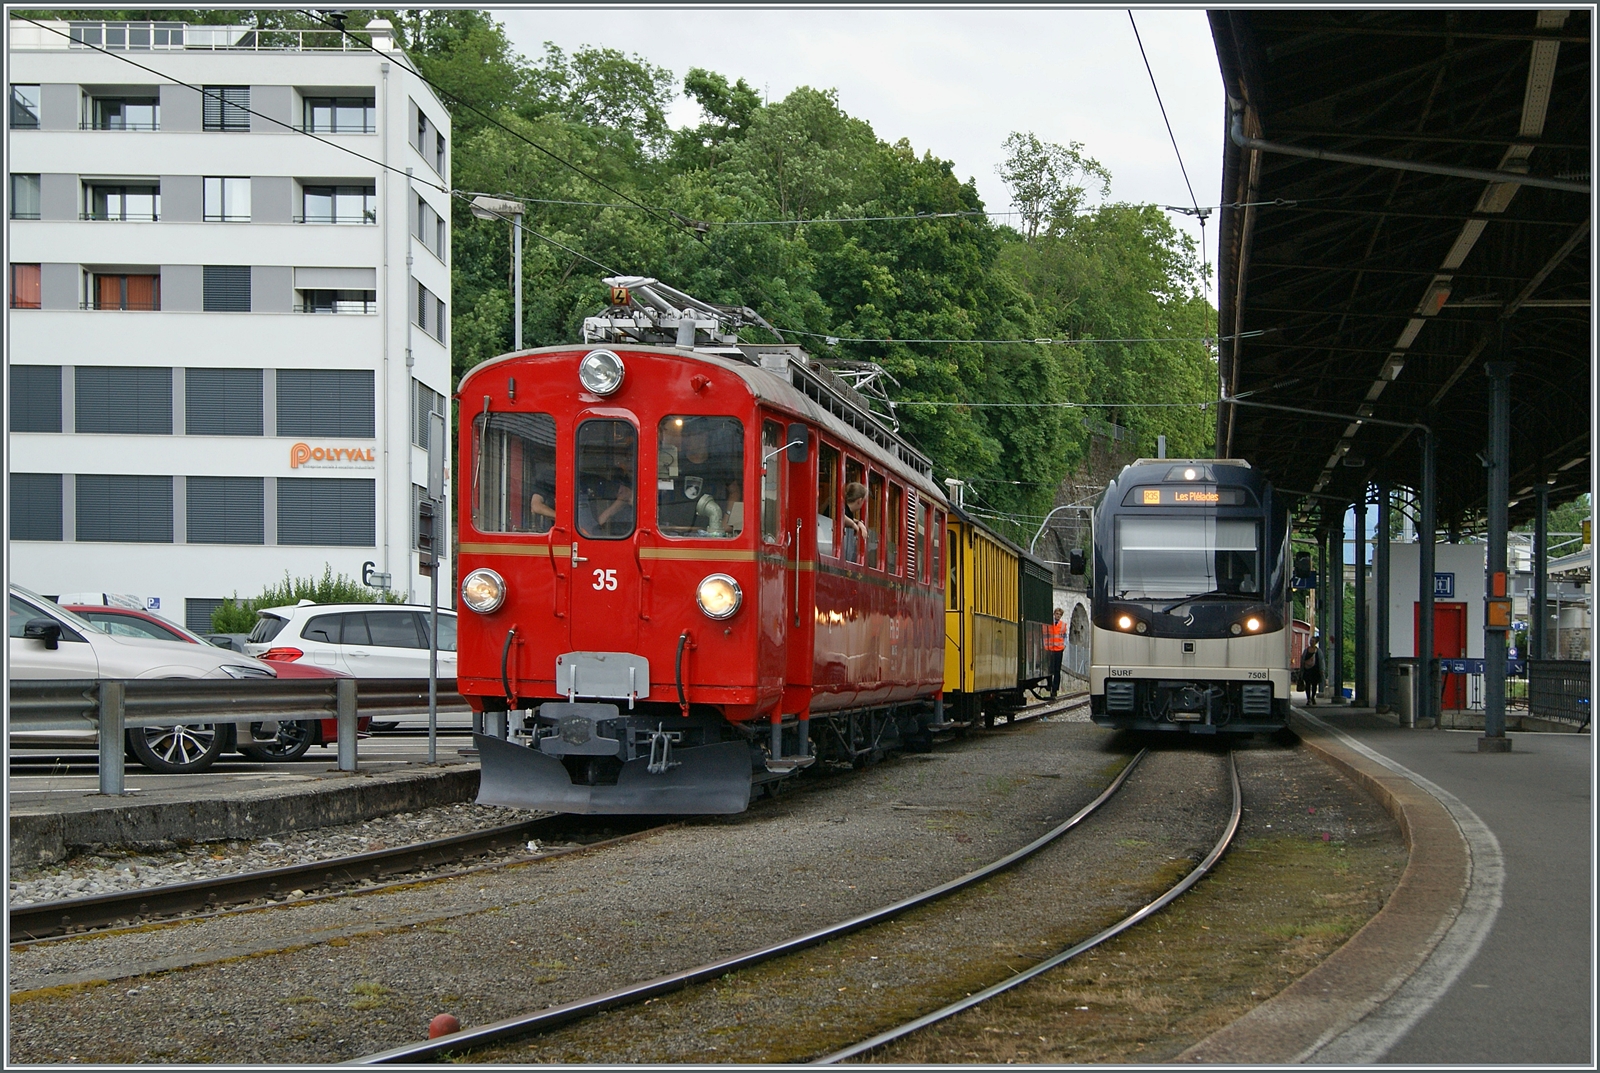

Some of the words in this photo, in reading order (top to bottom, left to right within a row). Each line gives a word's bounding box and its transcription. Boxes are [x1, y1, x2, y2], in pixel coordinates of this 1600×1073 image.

[291, 442, 375, 469] POLYVAL
[1175, 491, 1189, 501] Les
[1189, 491, 1219, 502] Pléiades
[362, 560, 376, 587] 6
[592, 568, 618, 591] 35
[1294, 576, 1301, 586] 7
[1111, 669, 1133, 677] SURF
